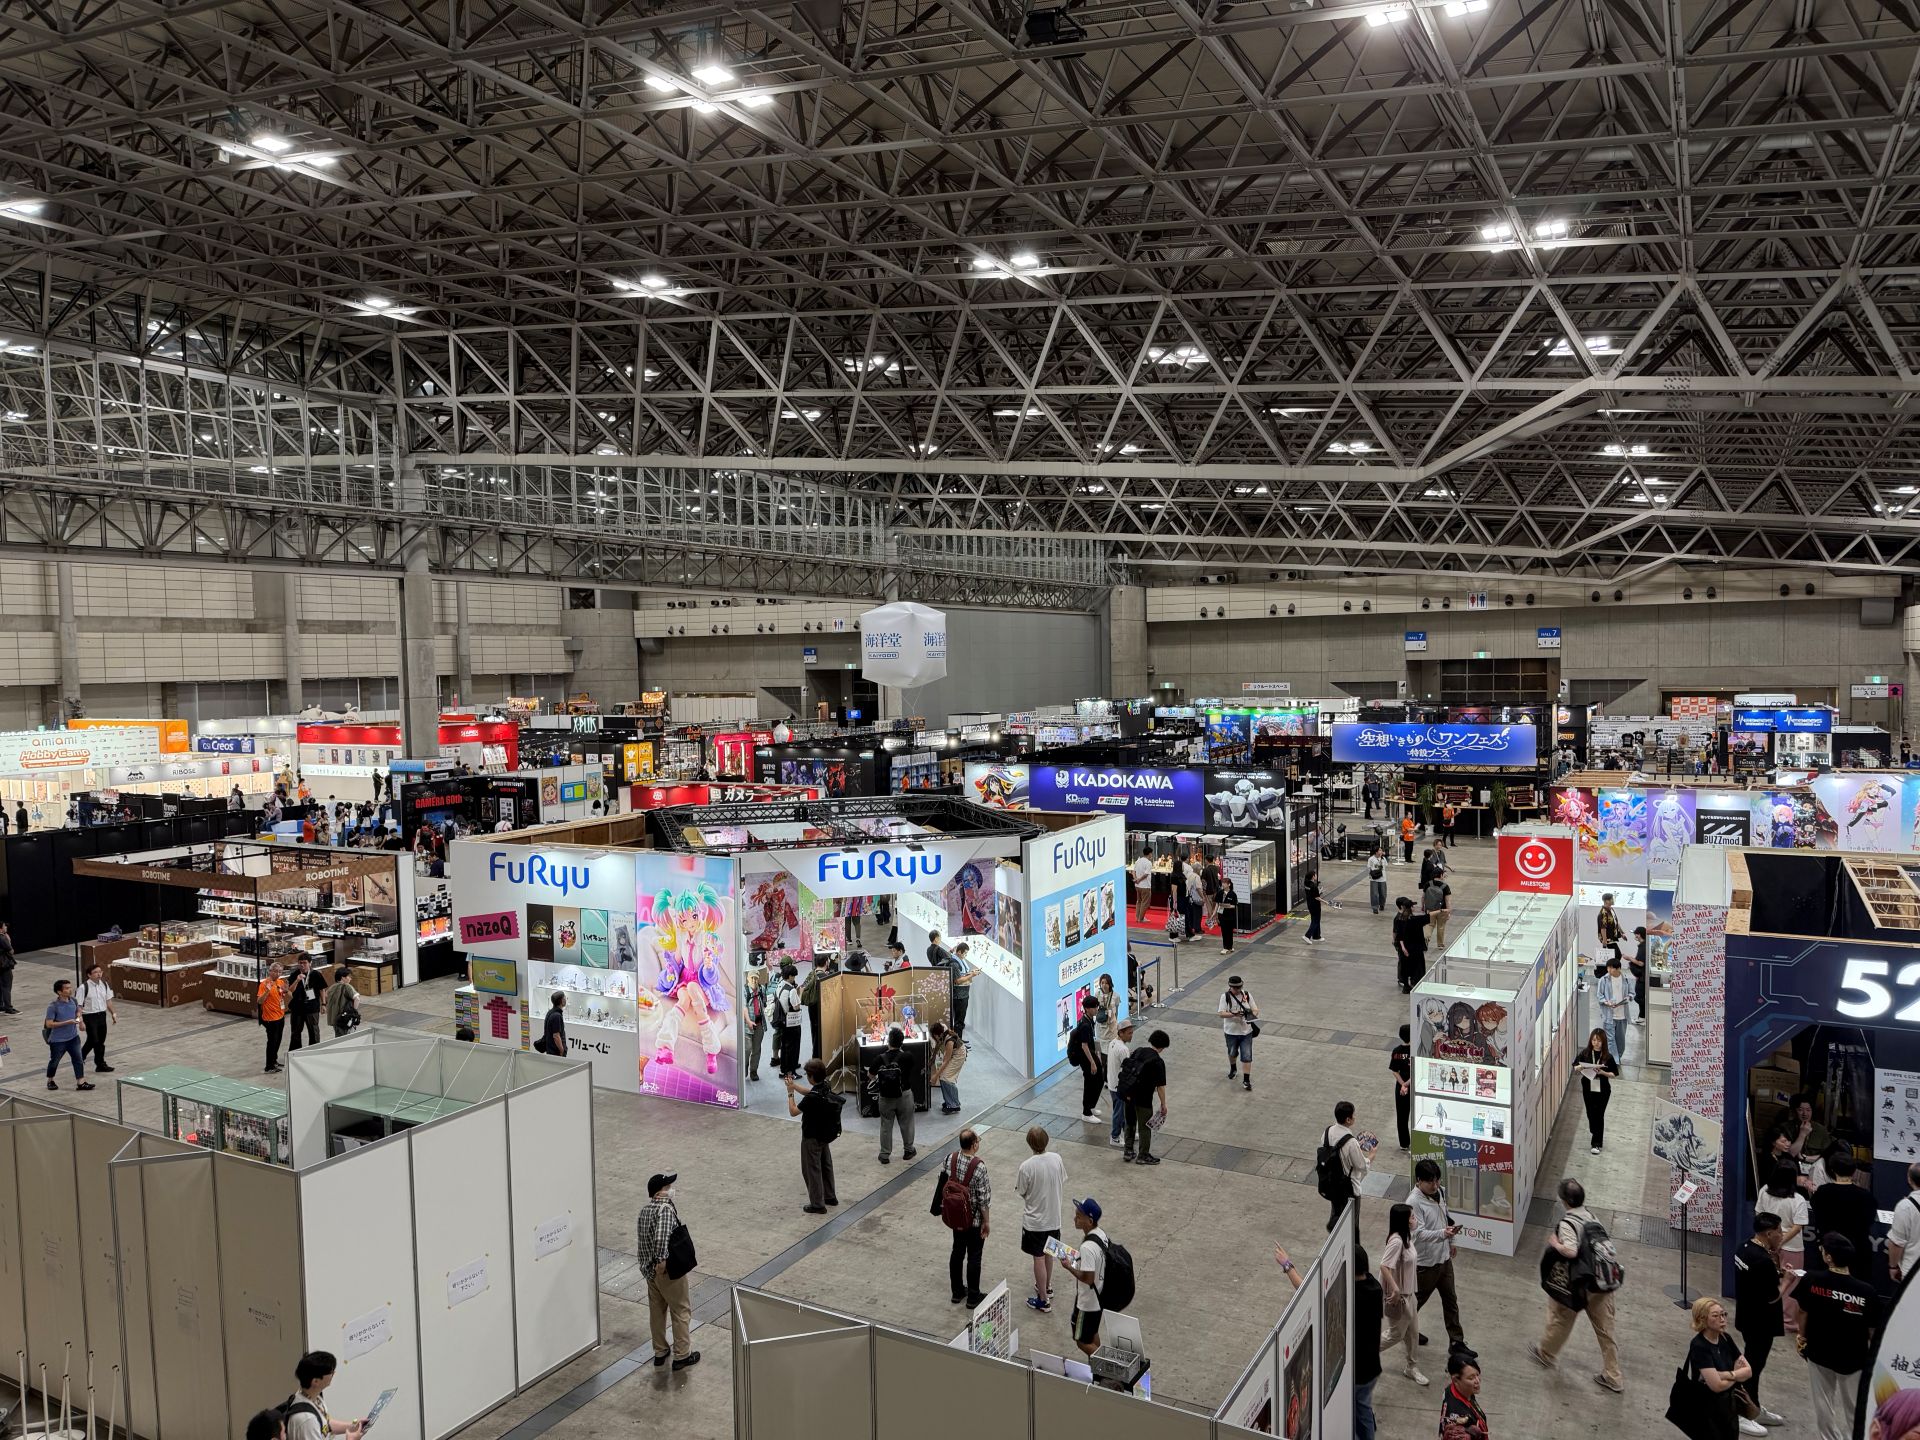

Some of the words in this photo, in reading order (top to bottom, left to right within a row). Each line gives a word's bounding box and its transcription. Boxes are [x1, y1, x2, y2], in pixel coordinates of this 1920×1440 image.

[865, 632, 902, 648] 海洋堂
[32, 736, 78, 746] amiami
[212, 740, 234, 750] Creos
[19, 750, 58, 761] Hobby
[58, 748, 91, 758] Camp
[1410, 749, 1450, 758] 特設ブース
[1074, 773, 1173, 789] KADOKAWA
[415, 796, 445, 809] GAMERA
[446, 794, 463, 804] 60th
[725, 789, 755, 802] ガメラ
[164, 803, 177, 811] three
[1053, 835, 1106, 874] FuRyu
[305, 866, 349, 881] ROBOTIME
[489, 852, 590, 897] FuRyu
[818, 850, 942, 885] FuRyu
[142, 870, 170, 881] ROBOTIME
[466, 916, 512, 938] nazoQ
[1062, 952, 1102, 981] 制作発表コーナー
[123, 980, 158, 993] ROBOTIME
[215, 989, 251, 1002] ROBOTIME
[568, 1037, 611, 1055] フリューくじ
[1446, 1158, 1478, 1168] 男子便所
[1480, 1161, 1513, 1172] 洋式便所
[1811, 1286, 1866, 1306] MILESTONE
